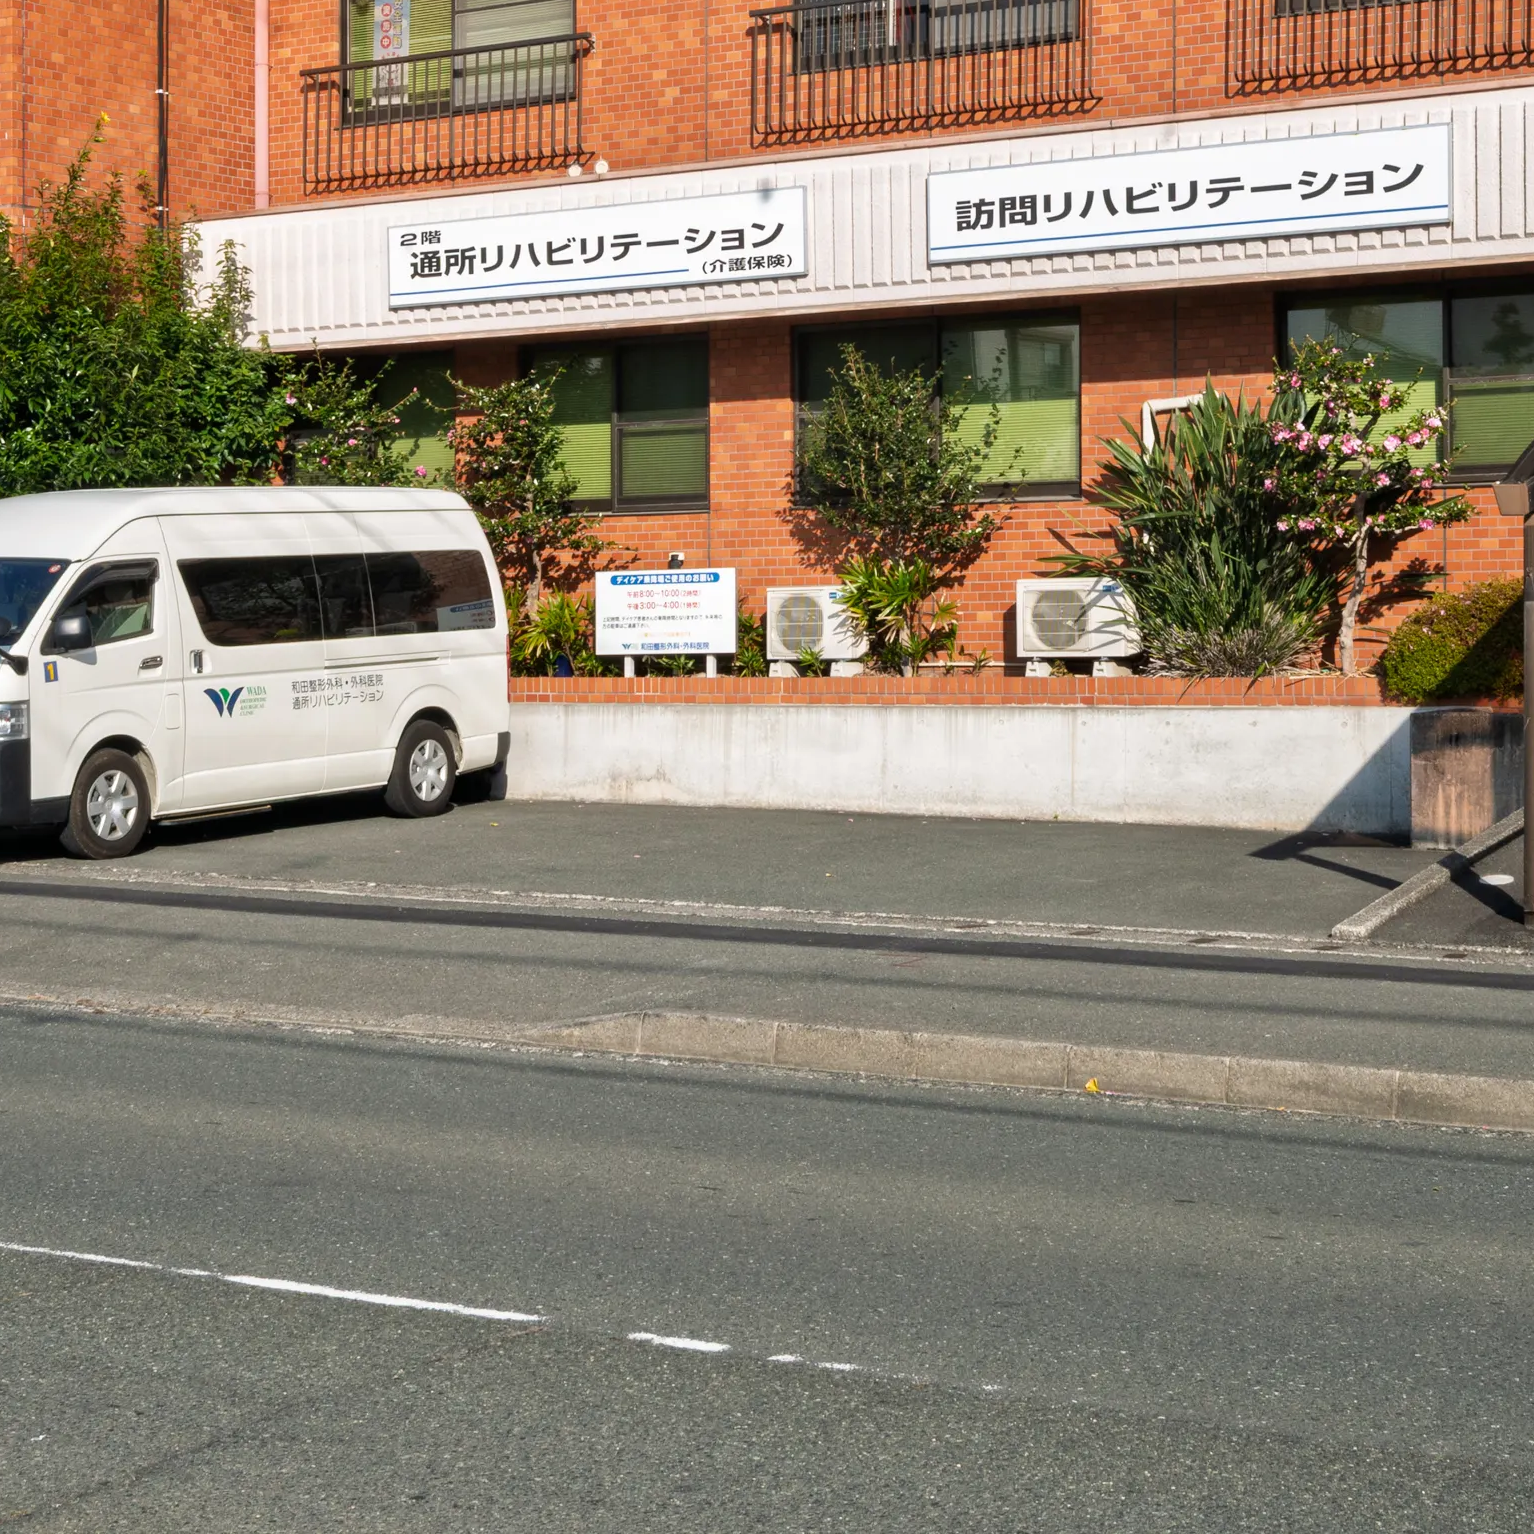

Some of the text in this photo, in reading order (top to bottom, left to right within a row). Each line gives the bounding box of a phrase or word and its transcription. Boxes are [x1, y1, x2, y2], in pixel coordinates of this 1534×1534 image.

[955, 163, 1425, 232] 訪問リハビリテーション
[399, 230, 442, 247] 2階
[410, 221, 785, 281] 通所リハビリテーション
[701, 253, 793, 275] (介護保険)
[641, 642, 709, 650] 和田整形外科・外科医院
[46, 663, 55, 681] 1
[246, 685, 267, 696] WADA
[291, 674, 384, 695] 和田整形外科・外科医院
[291, 690, 385, 711] 通所リハビリテーション
